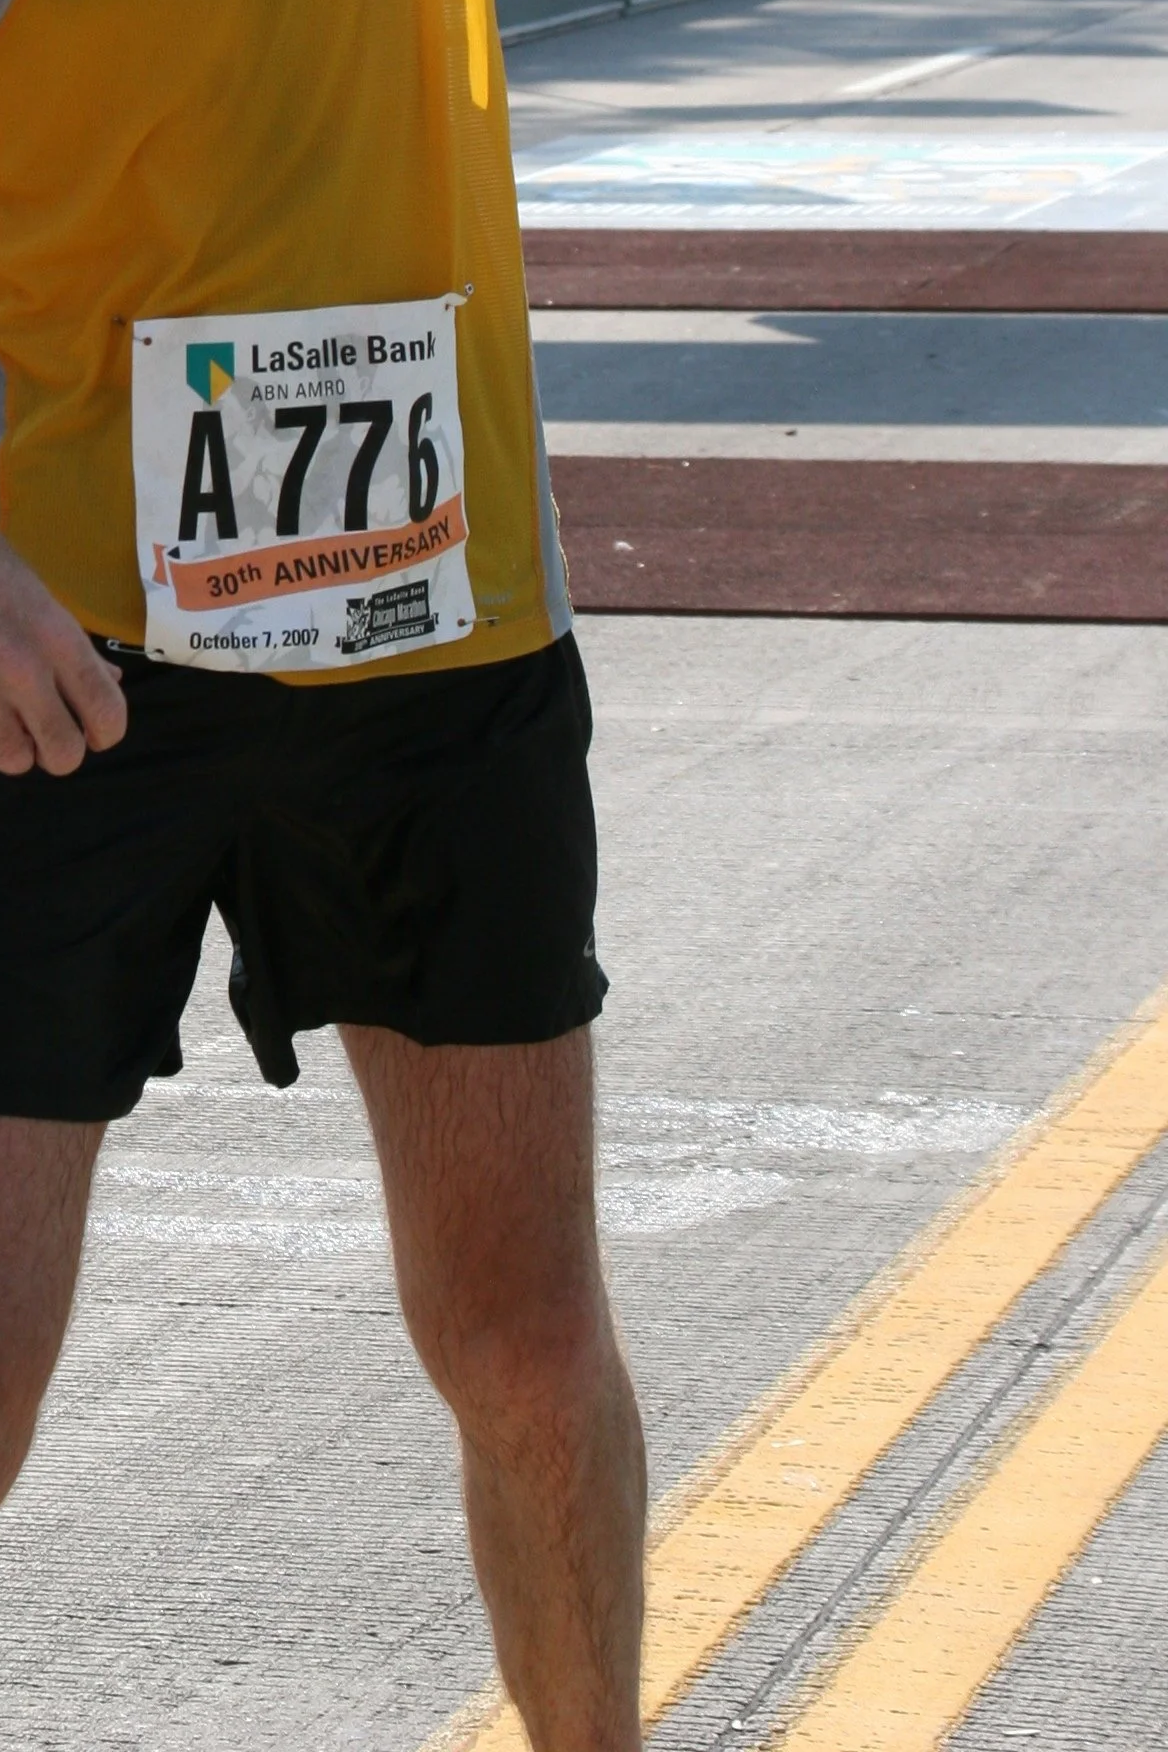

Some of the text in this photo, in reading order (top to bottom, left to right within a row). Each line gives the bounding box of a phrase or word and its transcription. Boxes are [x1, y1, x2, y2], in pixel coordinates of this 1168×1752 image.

[251, 330, 437, 374] LaSalle Bank
[250, 379, 346, 402] ABN AMRO
[206, 515, 451, 598] 30th ANNIVERSARY
[189, 628, 320, 651] October 7, 2007
